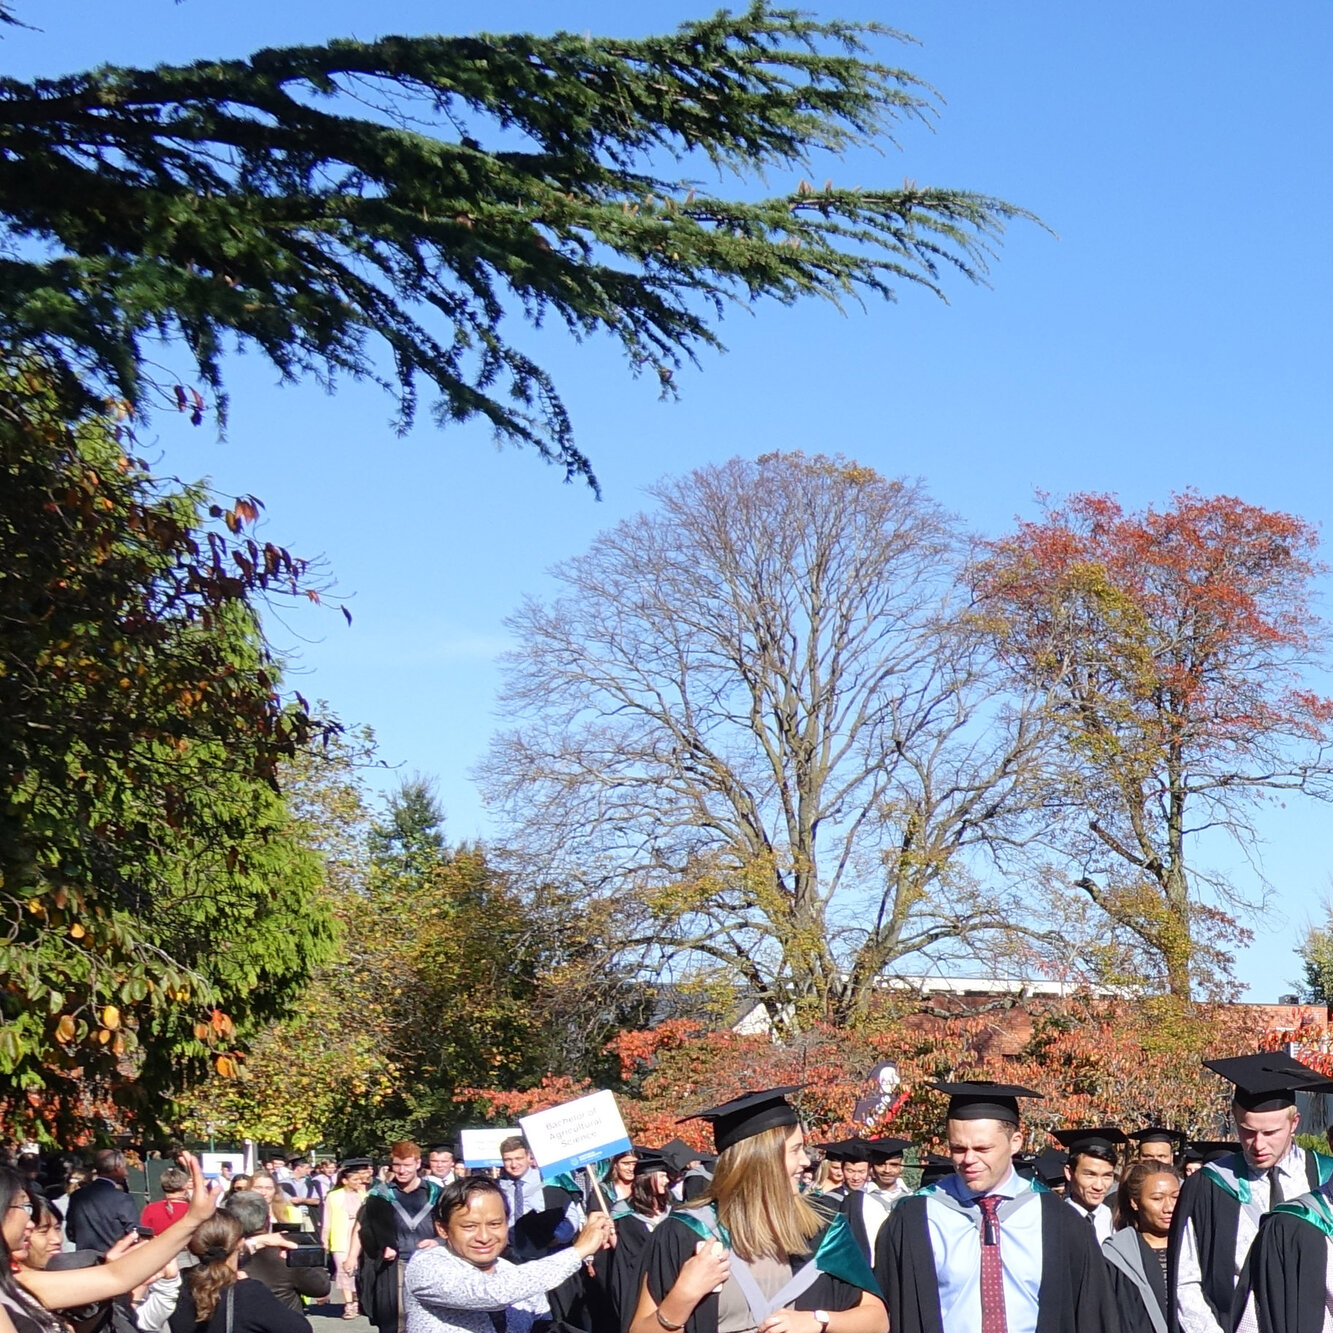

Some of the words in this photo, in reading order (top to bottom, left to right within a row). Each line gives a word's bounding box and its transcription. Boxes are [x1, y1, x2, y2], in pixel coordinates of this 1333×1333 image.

[545, 1111, 585, 1131] Bachelor
[587, 1107, 598, 1117] of
[549, 1116, 603, 1141] Agricultural
[560, 1131, 597, 1147] Science
